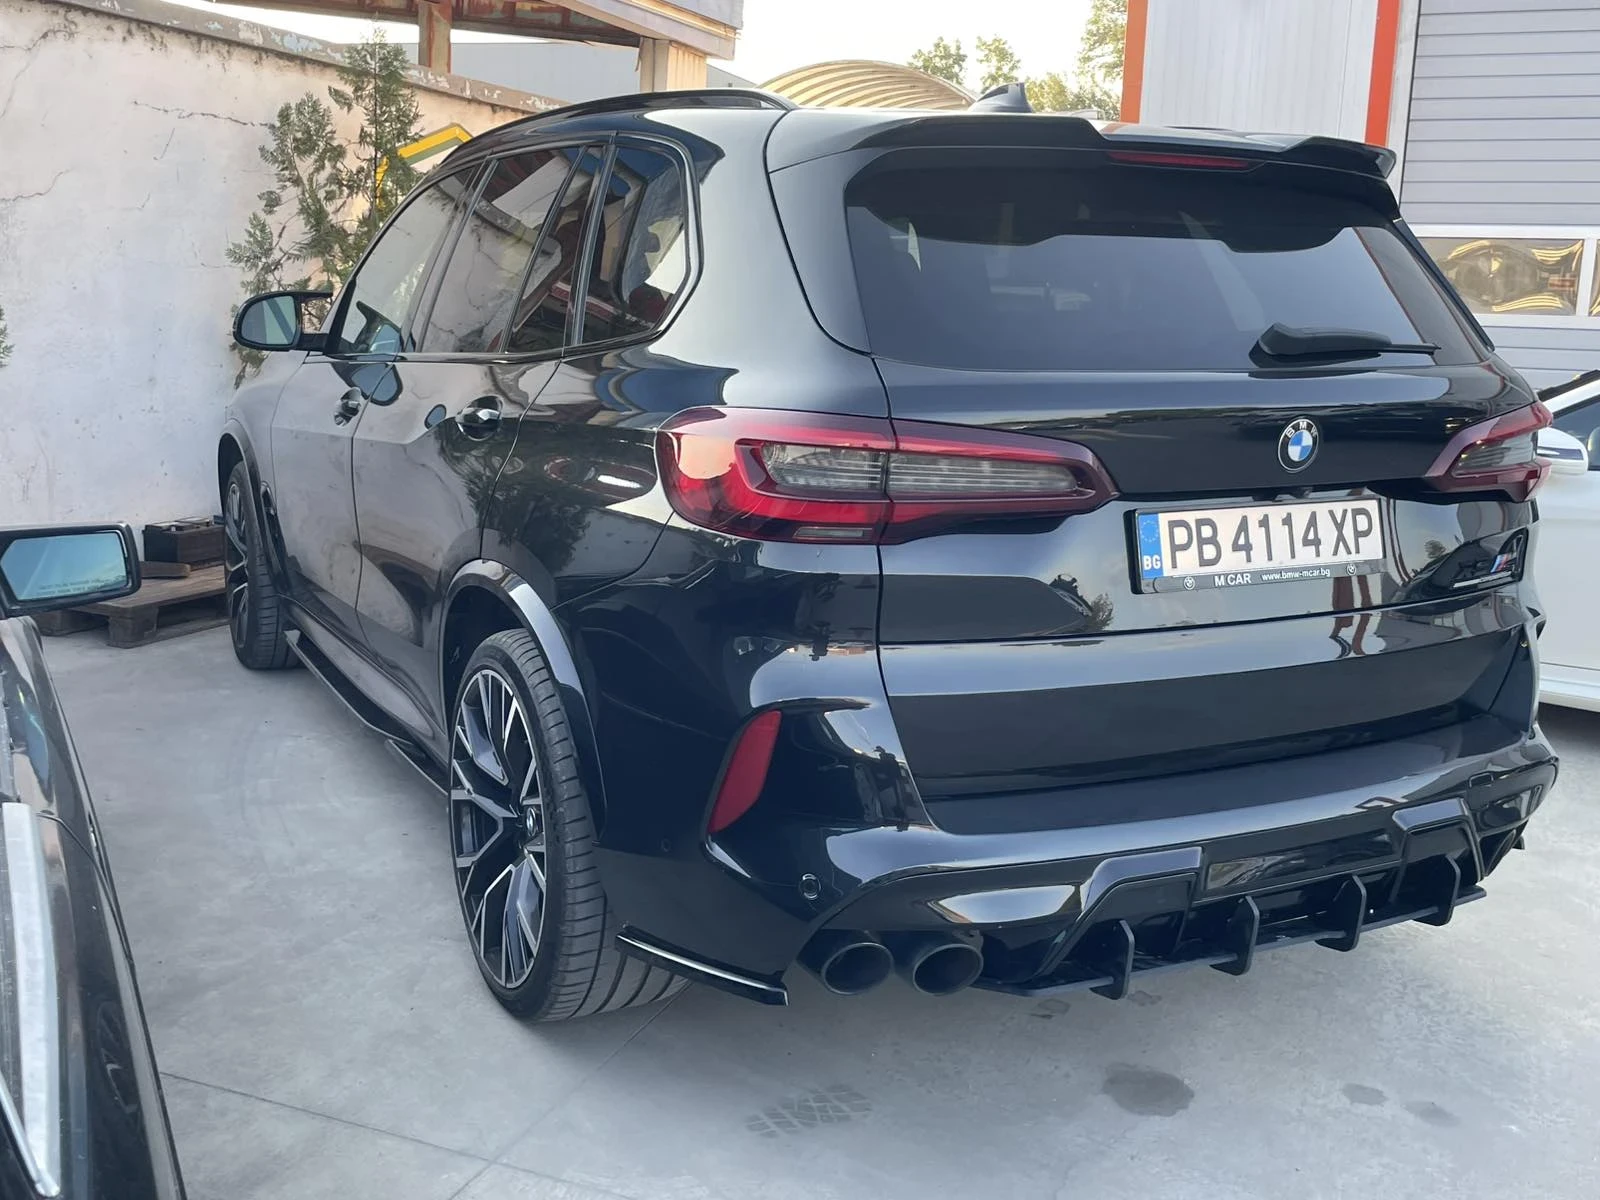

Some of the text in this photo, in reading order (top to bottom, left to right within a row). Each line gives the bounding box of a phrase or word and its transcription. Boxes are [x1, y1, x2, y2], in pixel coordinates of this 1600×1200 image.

[1167, 507, 1373, 569] PB 4114 XP
[1143, 554, 1161, 571] BG
[1214, 568, 1331, 587] M CAR www.bmw-mcar.bg
